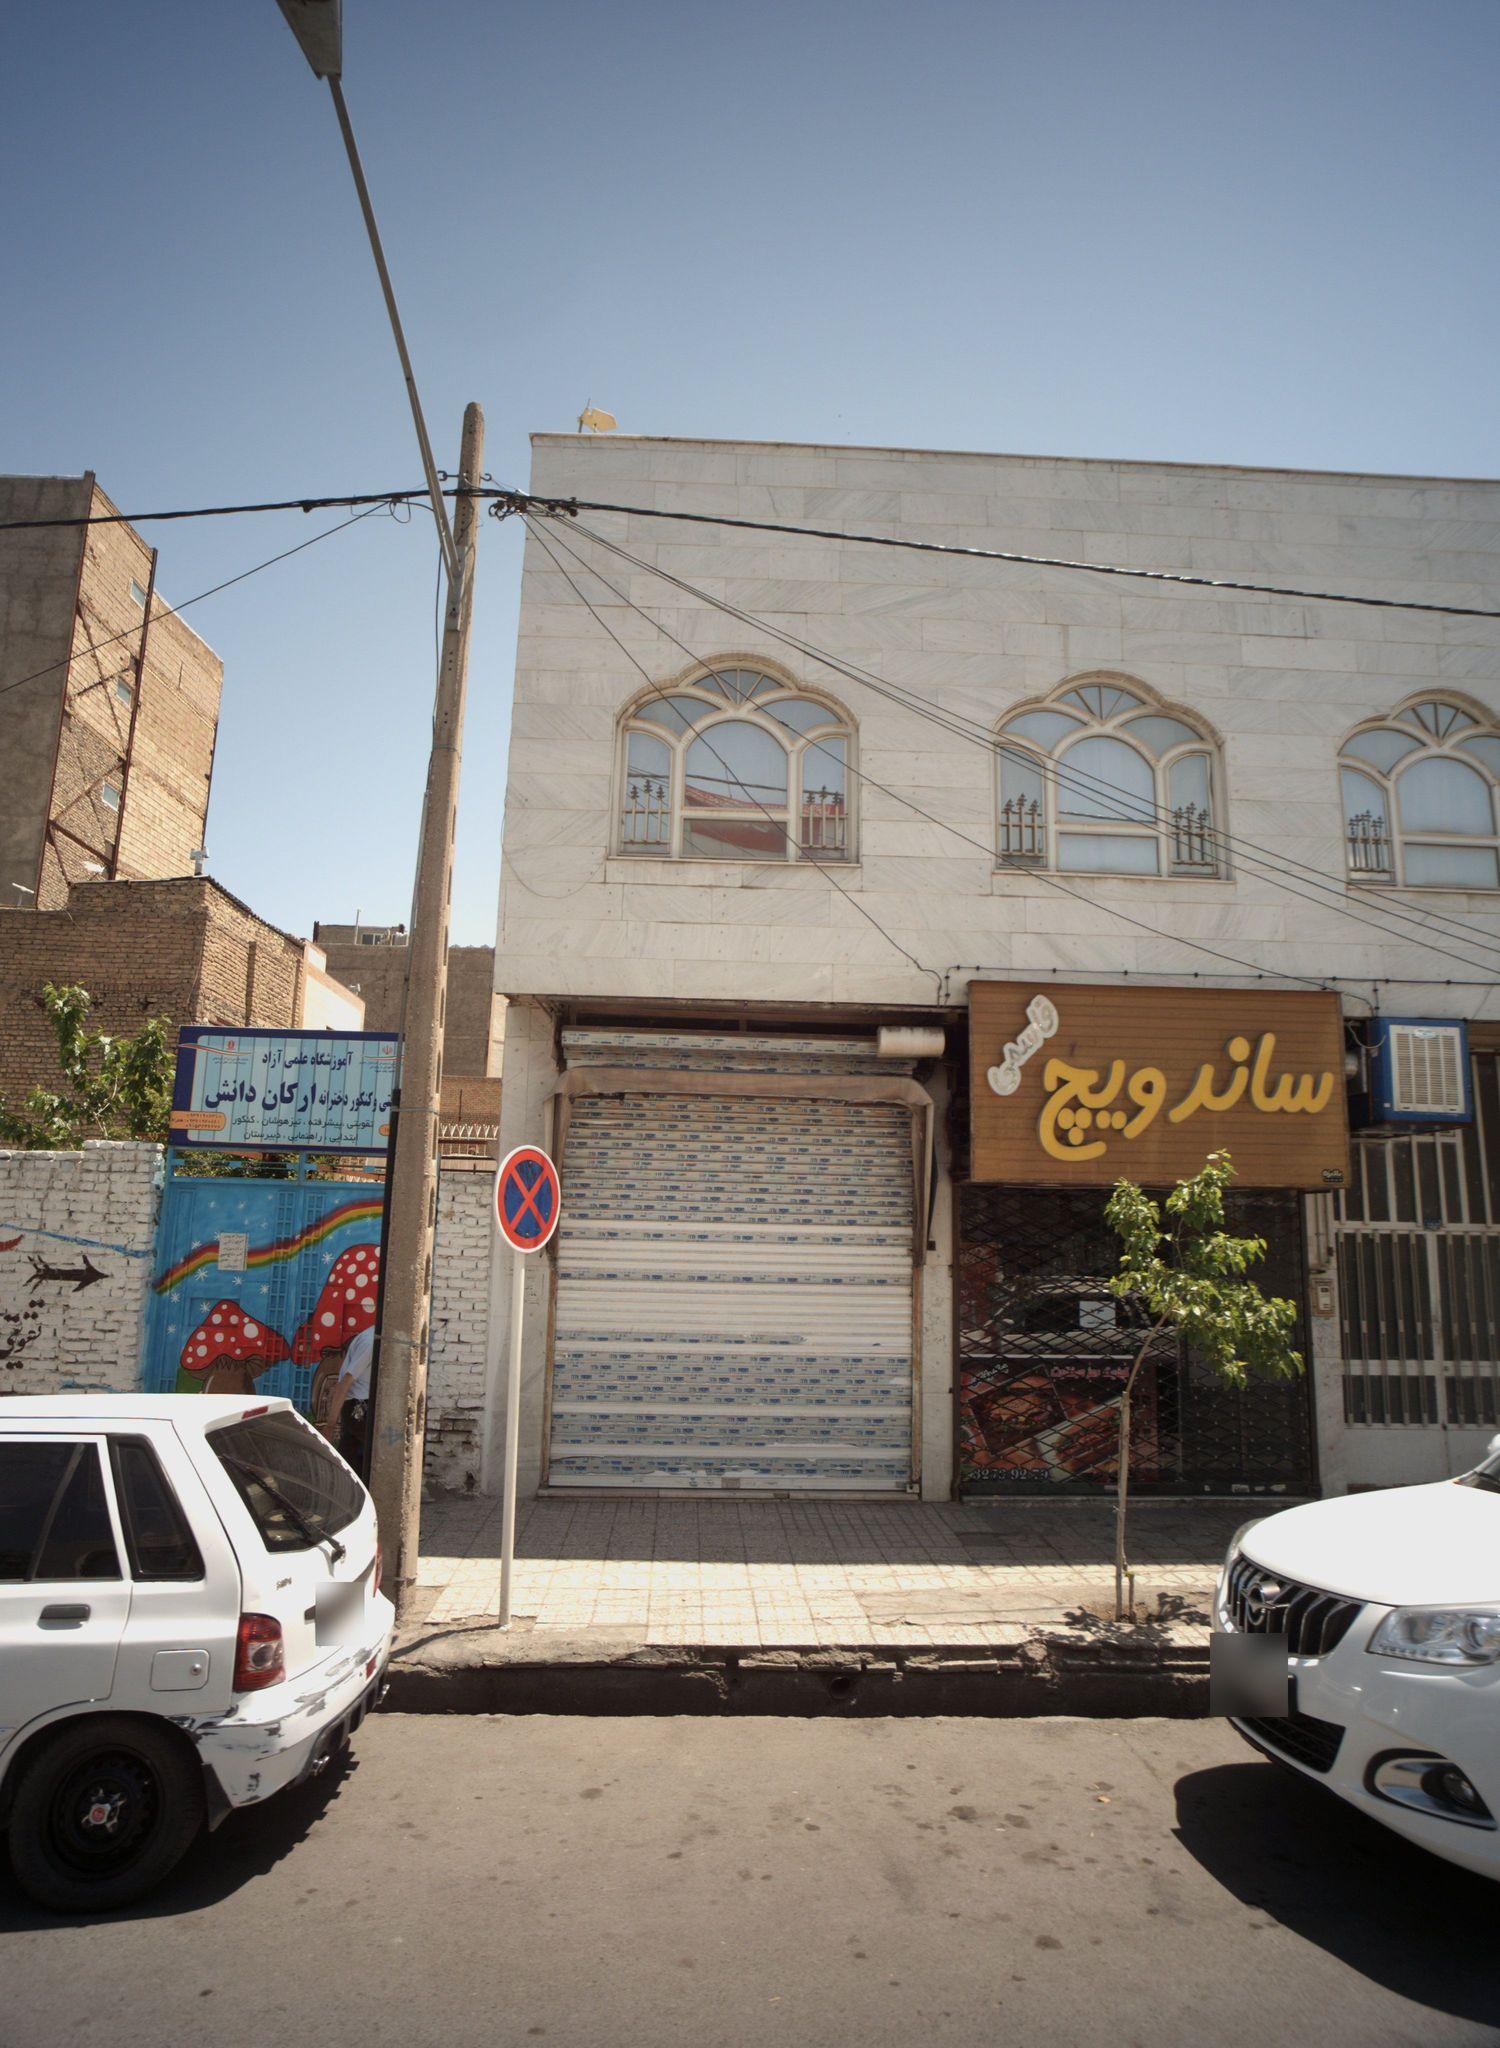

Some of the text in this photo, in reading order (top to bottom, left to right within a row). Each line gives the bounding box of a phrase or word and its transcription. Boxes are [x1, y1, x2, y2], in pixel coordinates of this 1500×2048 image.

[262, 1049, 283, 1068] آزاد
[284, 1051, 308, 1069] علمی
[311, 1051, 354, 1071] آموزشگاه
[205, 1079, 257, 1109] دانش
[261, 1081, 317, 1112] ارکان
[319, 1089, 348, 1111] دخترانه
[1037, 1031, 1334, 1162] ساندویچ
[232, 1115, 256, 1126] کنکور
[308, 1117, 342, 1129] پیشرفته
[243, 1130, 359, 1143] ابتدایی راهنمایی دبیرستان
